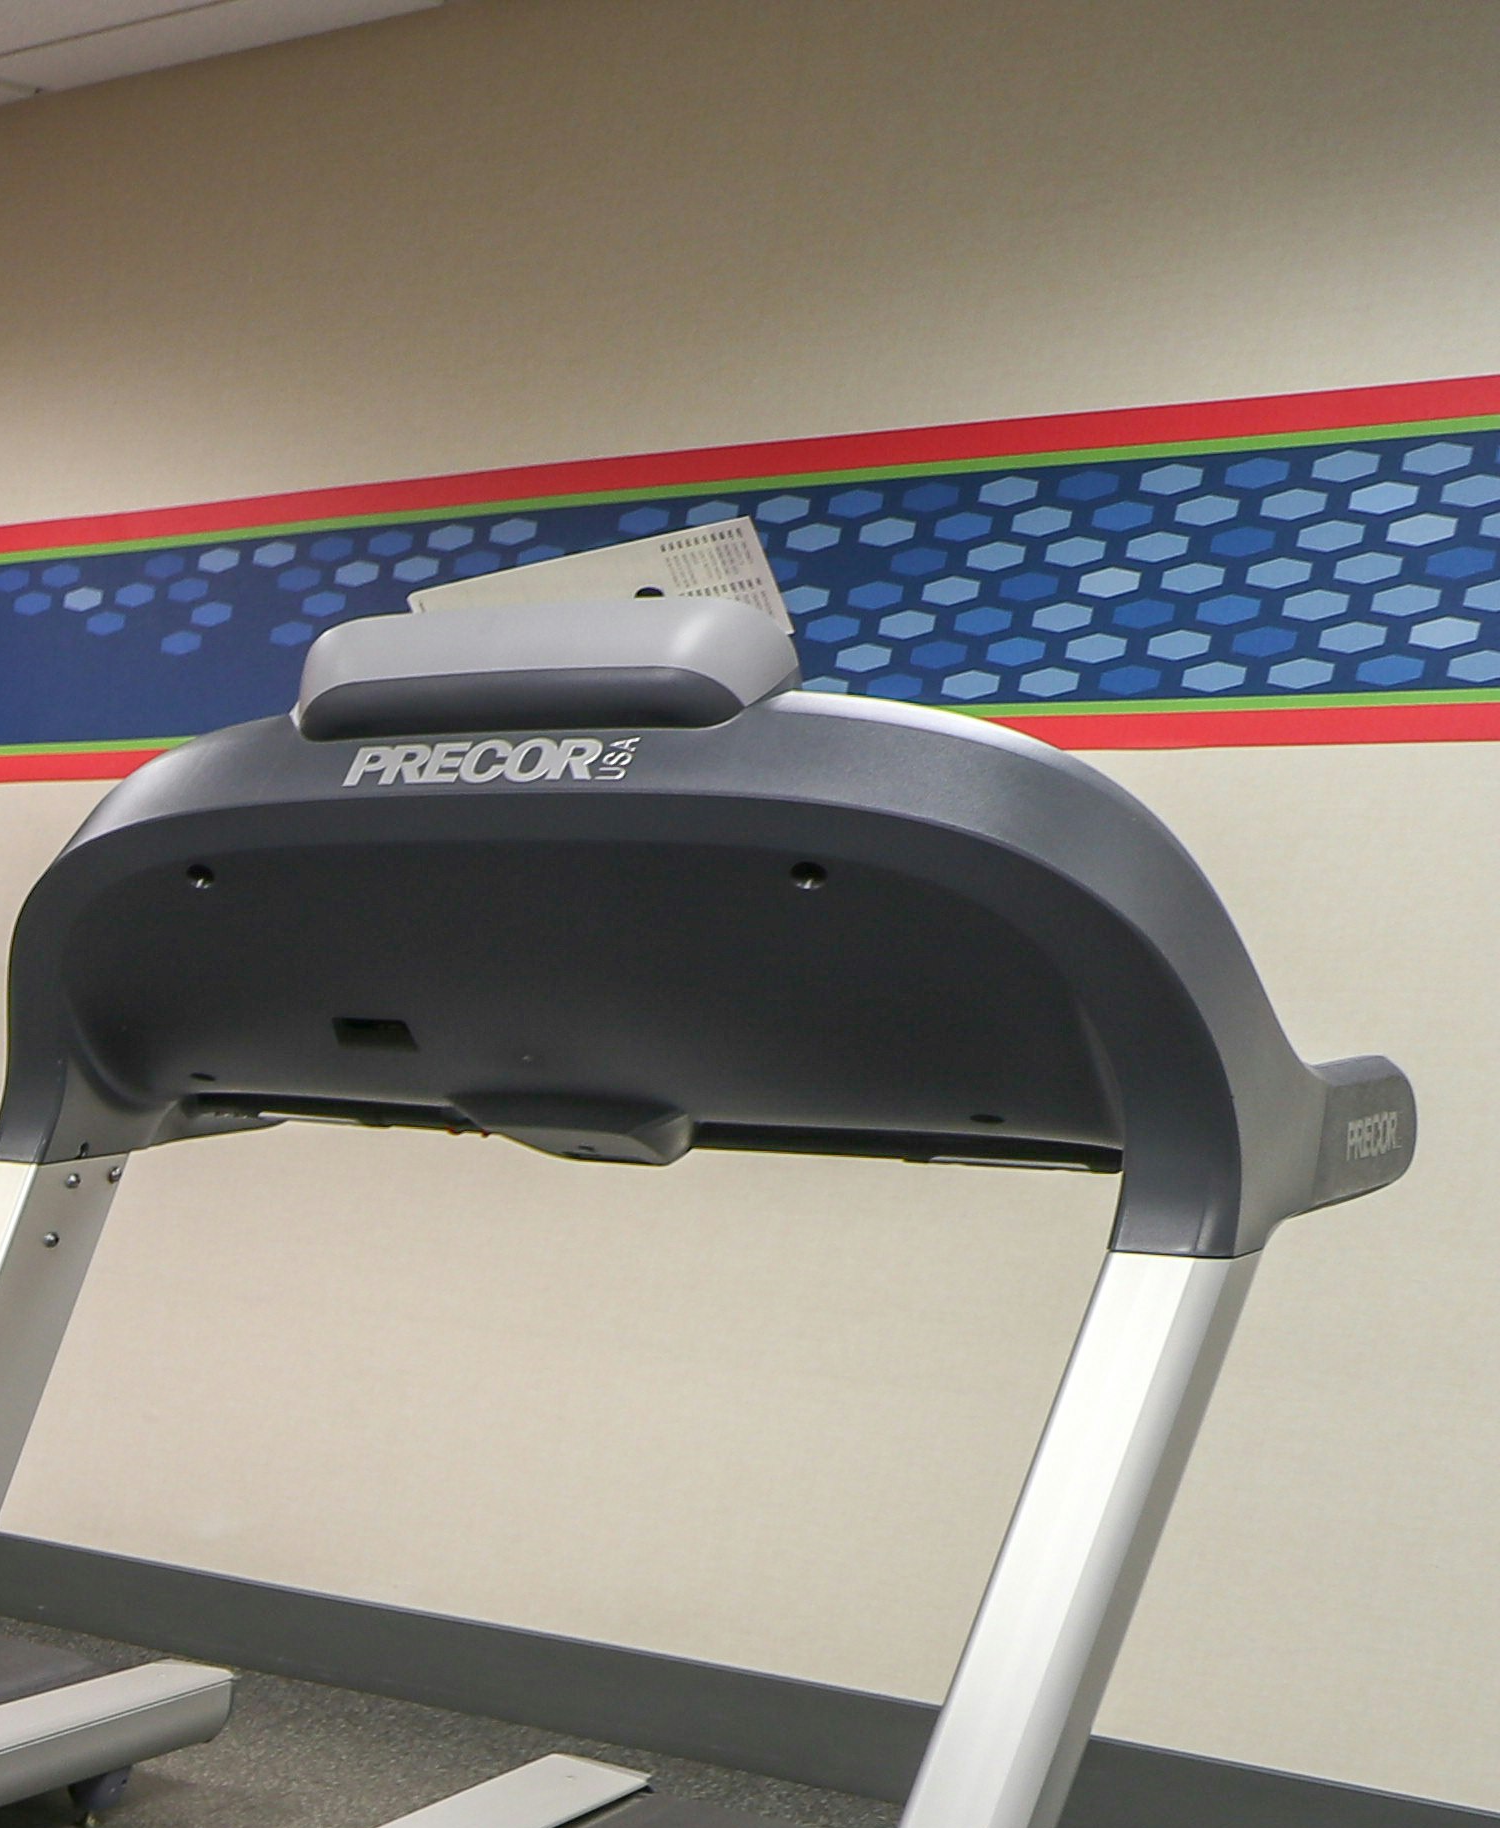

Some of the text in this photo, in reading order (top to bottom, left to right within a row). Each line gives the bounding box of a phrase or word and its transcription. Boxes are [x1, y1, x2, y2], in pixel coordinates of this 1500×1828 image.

[342, 736, 642, 787] PRECOR USA
[1346, 1110, 1398, 1161] PRECOR
